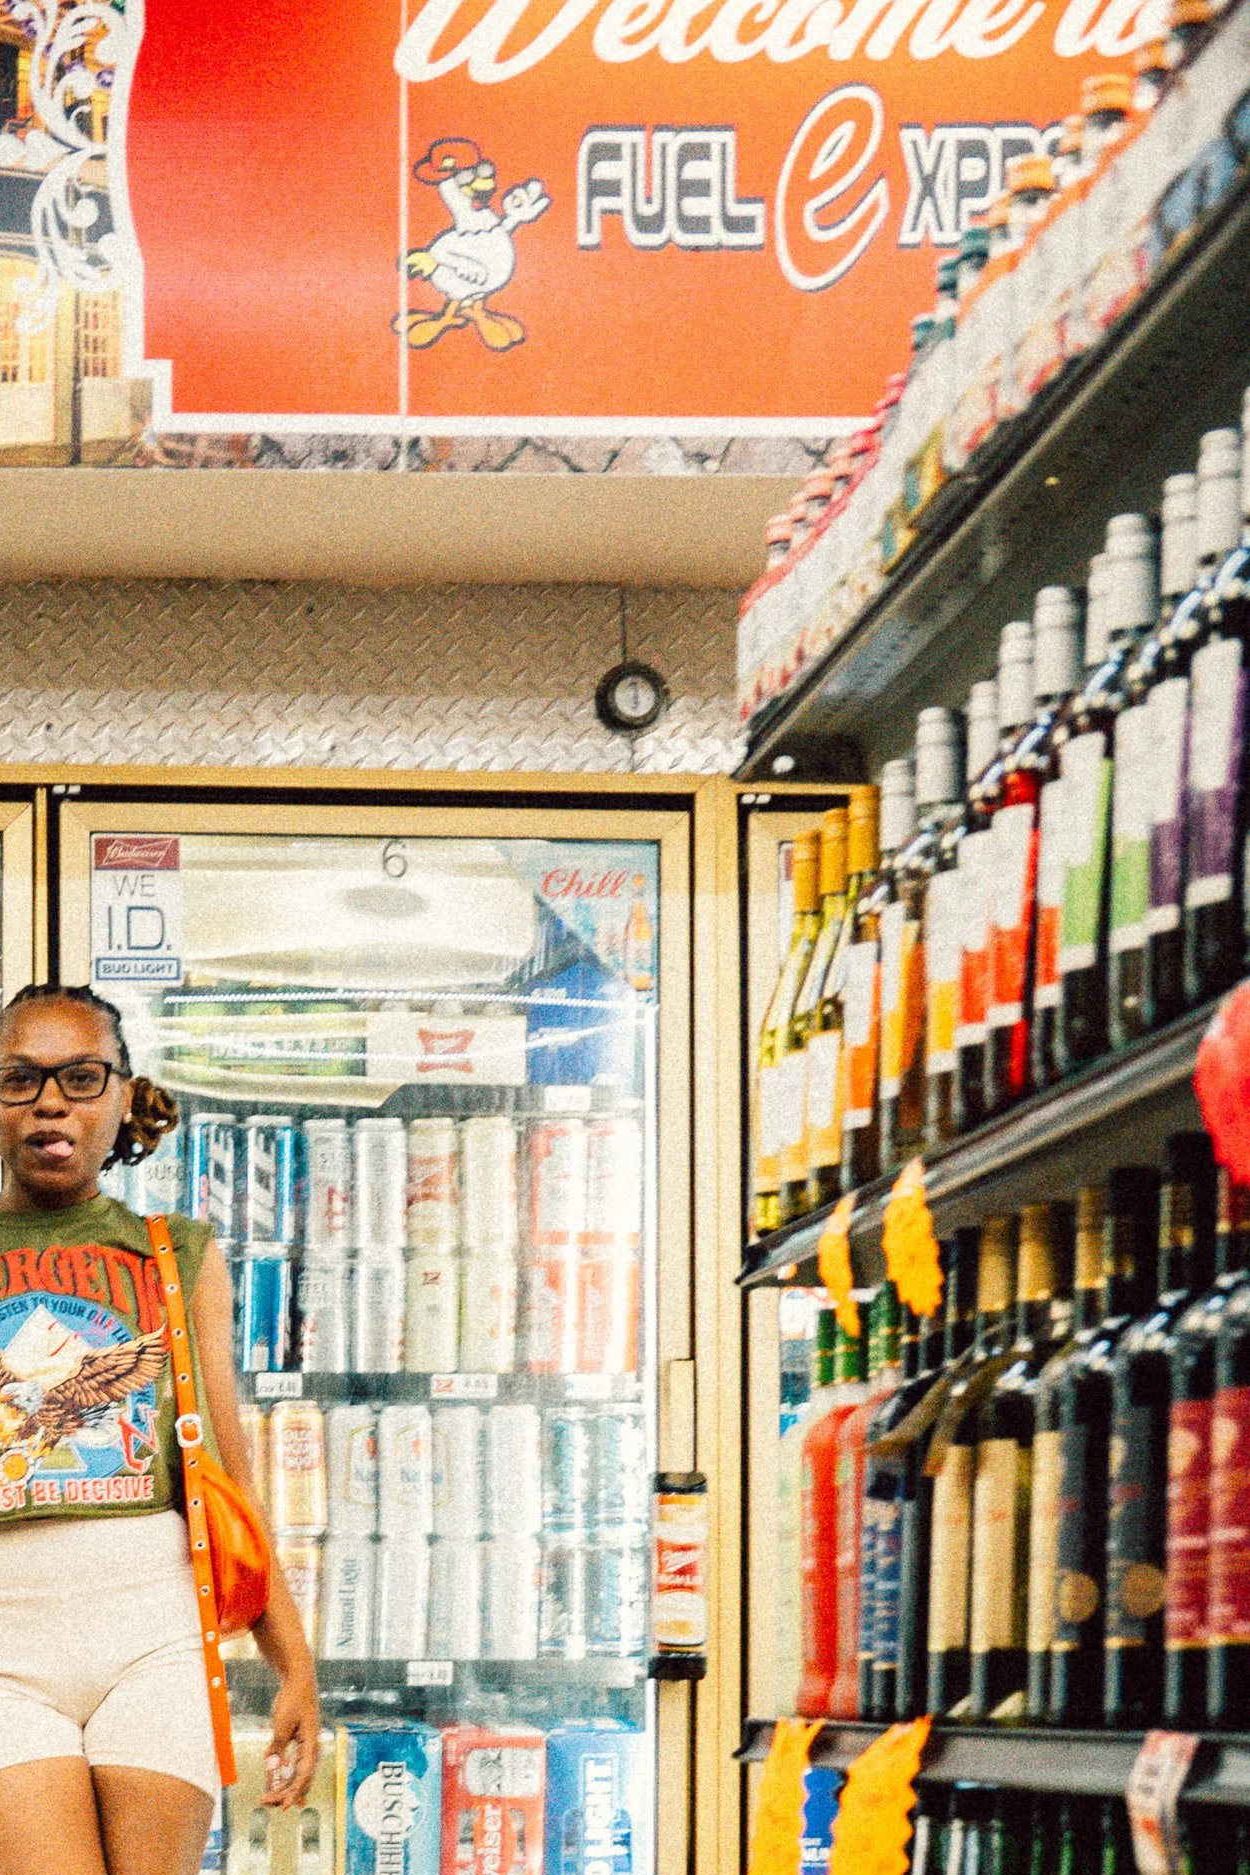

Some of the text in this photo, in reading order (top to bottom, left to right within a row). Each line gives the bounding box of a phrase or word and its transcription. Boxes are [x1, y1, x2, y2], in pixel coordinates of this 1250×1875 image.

[393, 0, 1048, 84] Welcome
[578, 125, 764, 251] FUEL
[381, 839, 409, 879] 6
[113, 873, 156, 898] WE
[541, 867, 628, 898] Chill
[107, 905, 172, 951] I.D.
[102, 963, 174, 975] BUD LIGHT
[34, 1481, 60, 1504] BE
[68, 1474, 154, 1502] DECISIVE
